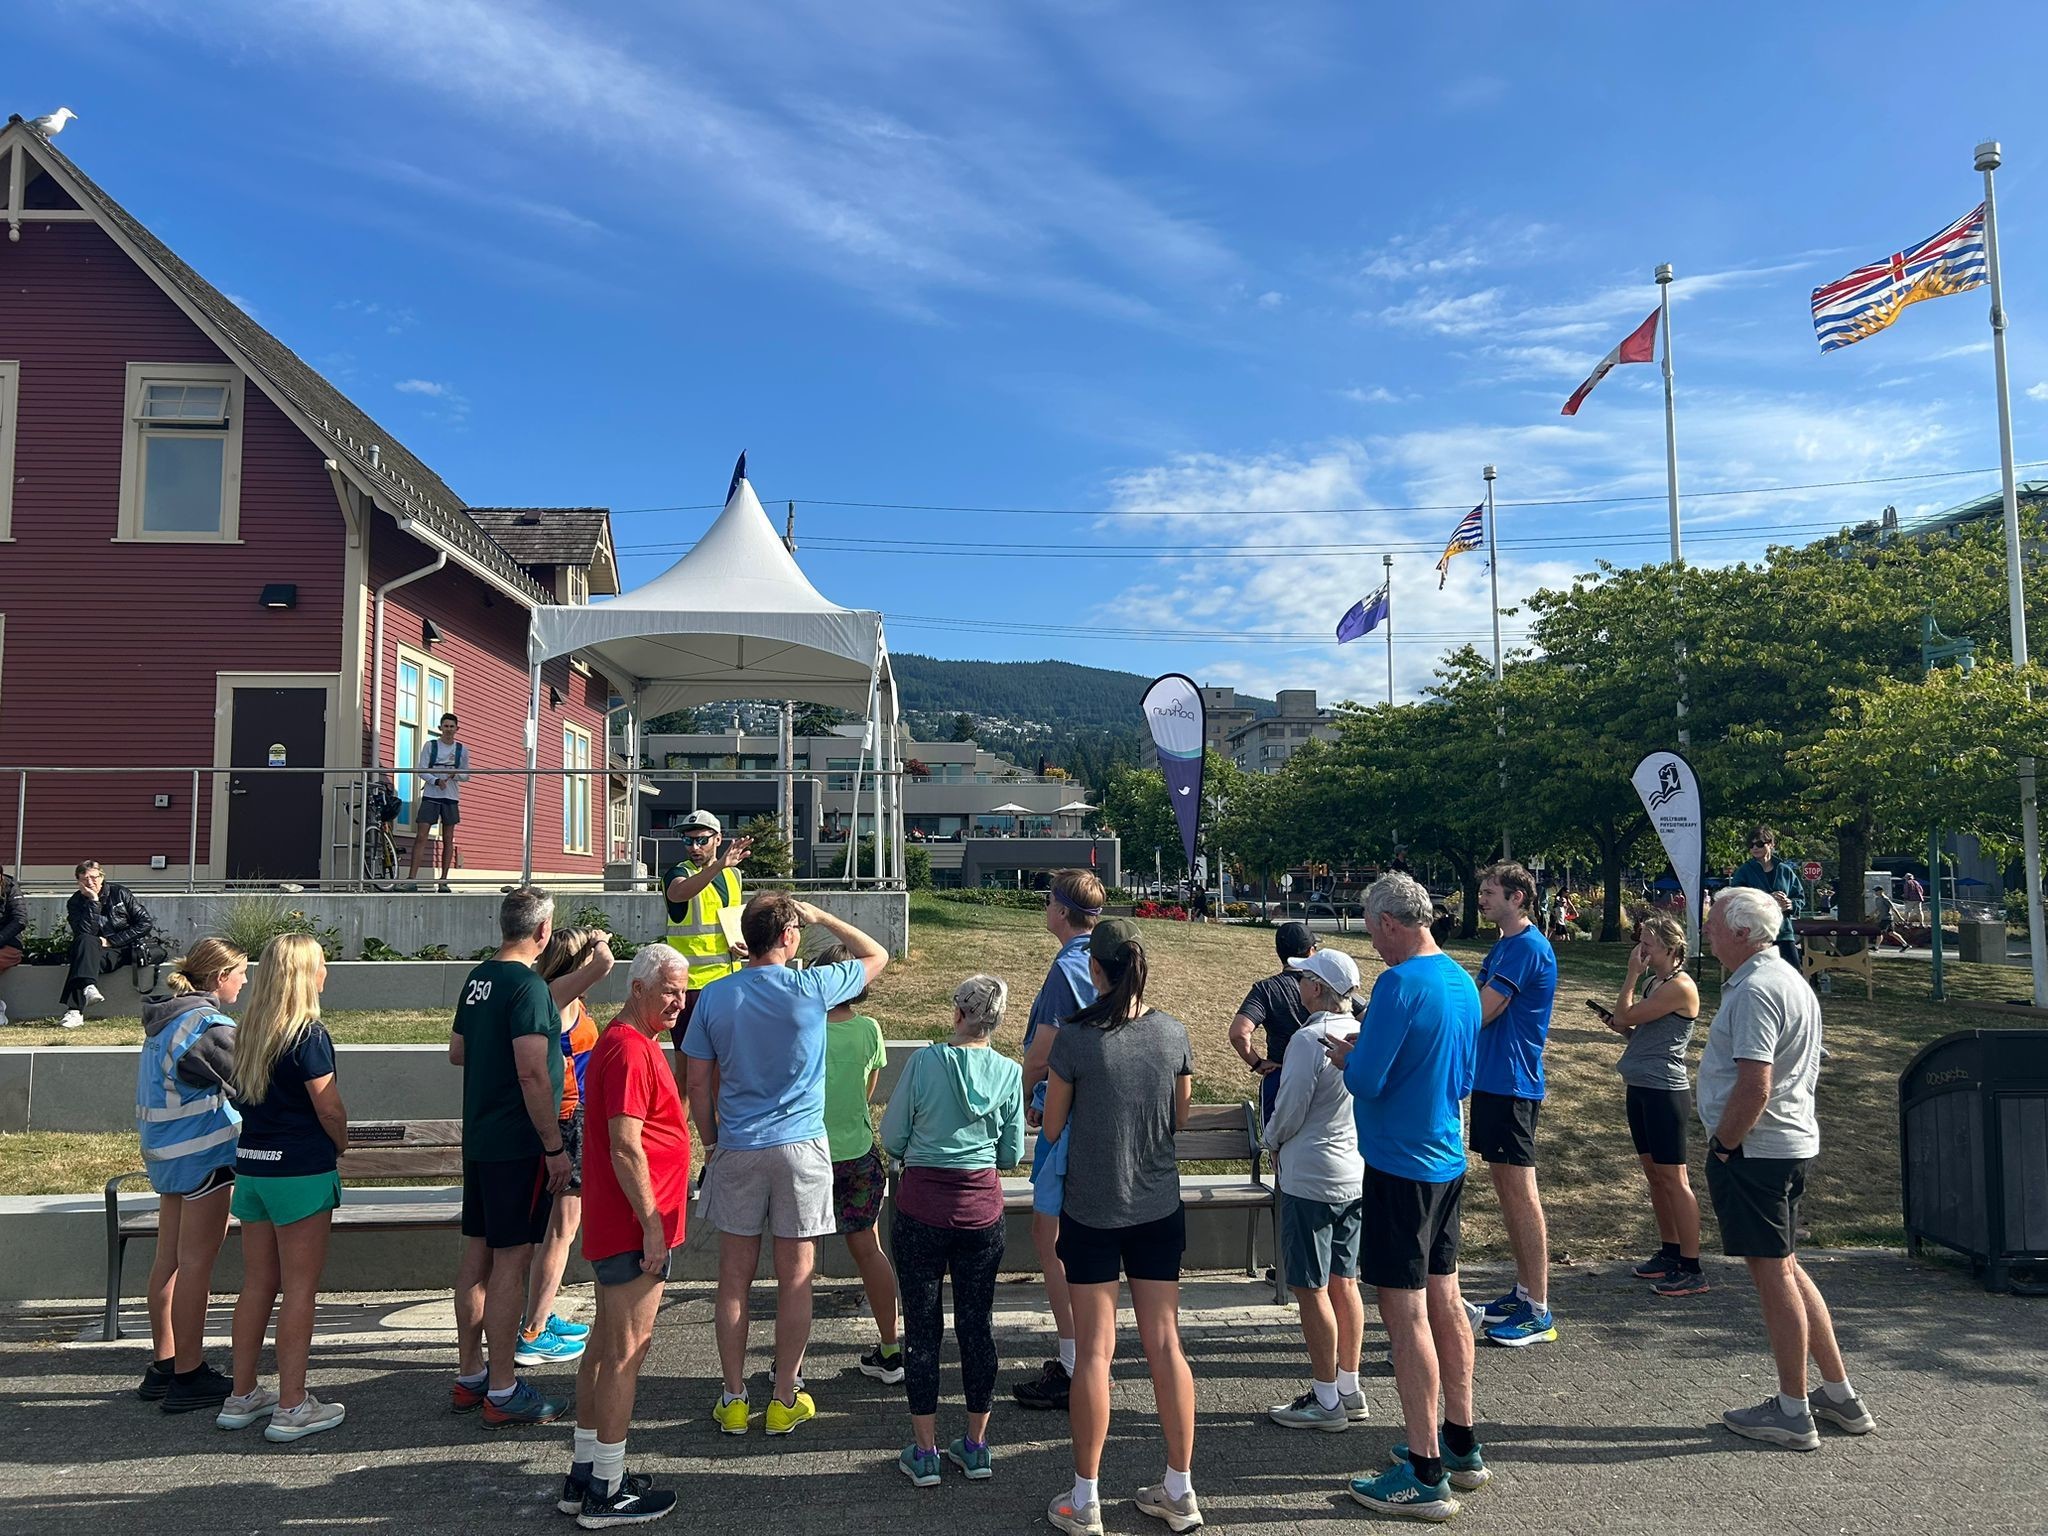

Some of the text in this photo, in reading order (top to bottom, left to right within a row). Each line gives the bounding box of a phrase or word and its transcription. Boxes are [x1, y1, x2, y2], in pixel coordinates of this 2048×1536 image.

[1804, 867, 1821, 875] STOP
[465, 979, 492, 1005] 250
[1385, 1486, 1420, 1503] HOKA
